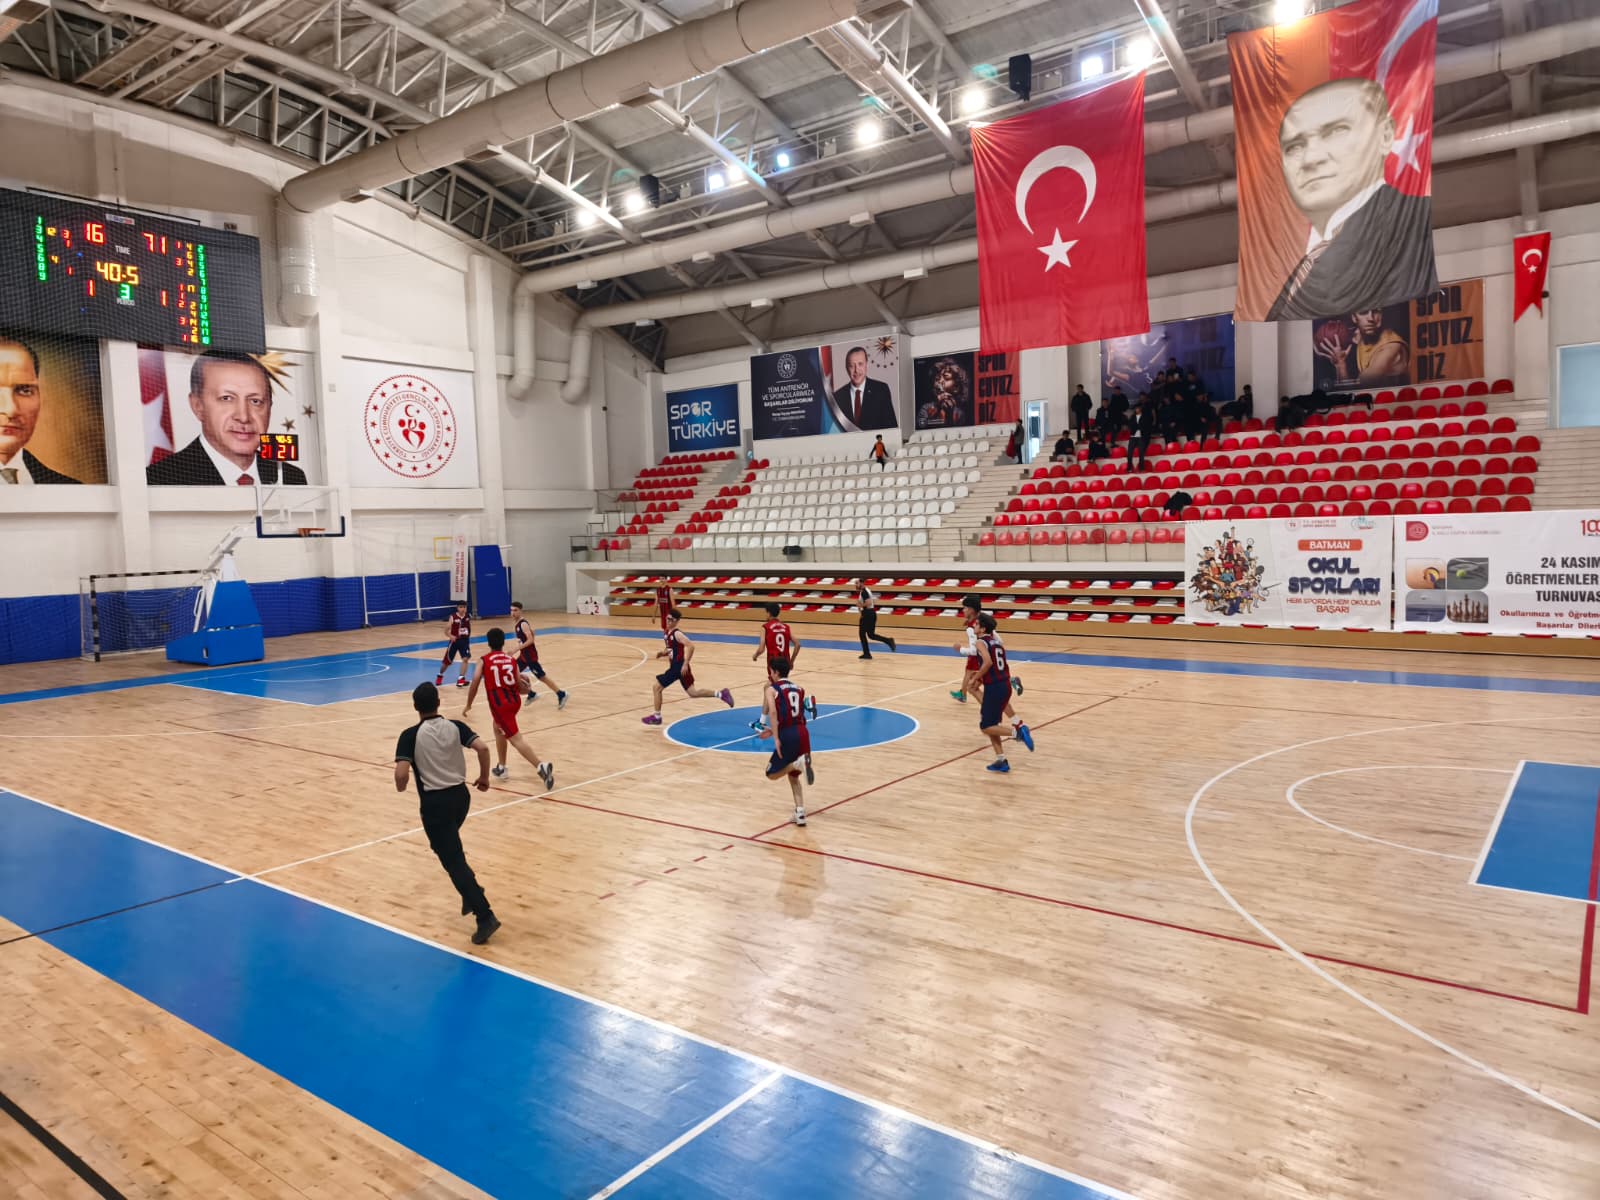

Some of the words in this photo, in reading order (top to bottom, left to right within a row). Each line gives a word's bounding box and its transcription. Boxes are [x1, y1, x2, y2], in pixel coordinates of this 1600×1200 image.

[86, 223, 104, 243] 16
[143, 233, 166, 255] 71
[115, 245, 131, 255] TIME
[120, 283, 130, 300] 3
[670, 400, 712, 420] SPOR
[671, 418, 737, 441] TÜRKİYE
[278, 444, 295, 459] 21
[1309, 540, 1351, 550] BATMAN
[1307, 556, 1360, 574] OKUL
[1540, 556, 1557, 569] 24
[1560, 556, 1600, 569] KASIM
[1287, 576, 1381, 596] SPORLARI
[1505, 571, 1599, 586] ÖĞRETMENLER
[1315, 605, 1350, 614] BAŞARI
[1332, 598, 1350, 606] HEM
[775, 633, 785, 652] 9
[994, 647, 1005, 671] 6
[490, 664, 516, 688] 13
[787, 691, 800, 718] 9
